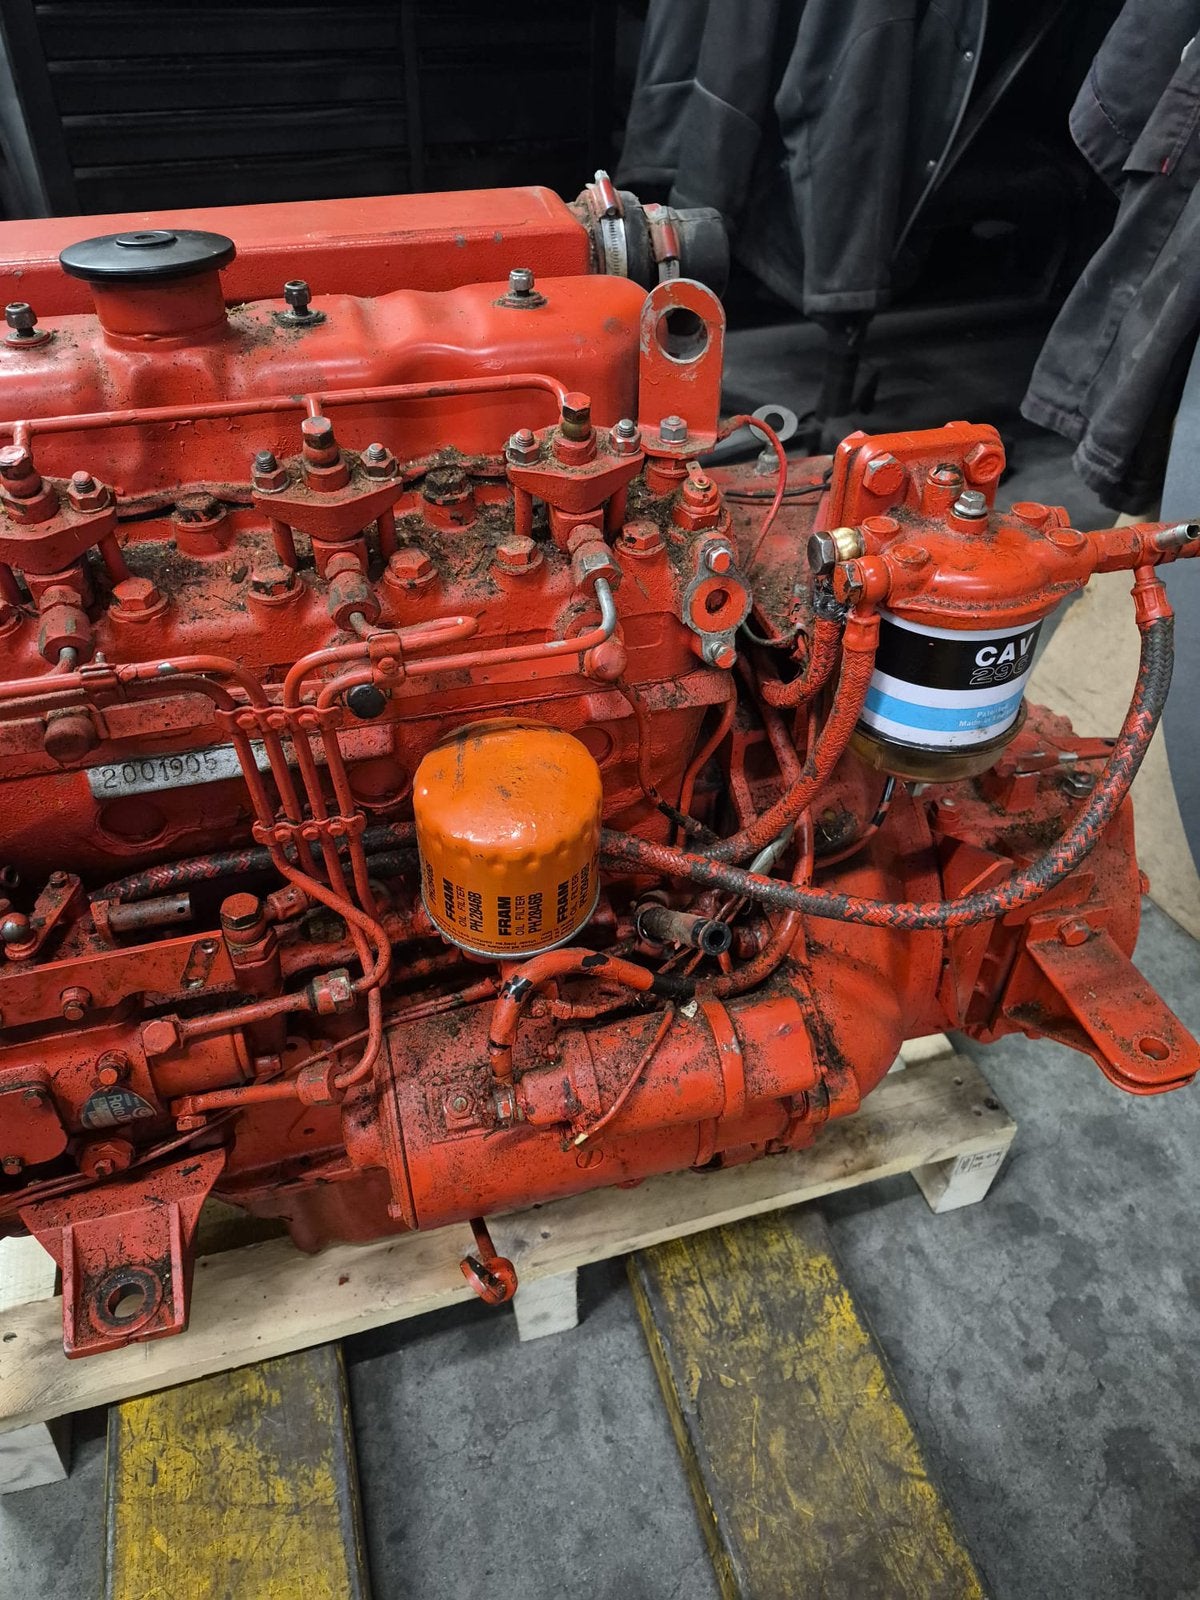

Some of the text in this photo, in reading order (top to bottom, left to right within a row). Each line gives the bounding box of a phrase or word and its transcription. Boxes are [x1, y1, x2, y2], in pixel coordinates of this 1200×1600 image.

[969, 654, 1028, 685] 296
[975, 632, 1035, 667] CAV
[102, 751, 217, 789] 2001905
[442, 876, 456, 923] FRAM
[456, 885, 467, 928] OIL FILTER
[557, 879, 569, 924] FRAM
[571, 872, 579, 901] FILTER
[468, 890, 484, 934] PH2846B
[497, 896, 512, 936] FRAM
[515, 895, 525, 936] OIL FILTER
[528, 892, 543, 934] PH2846B
